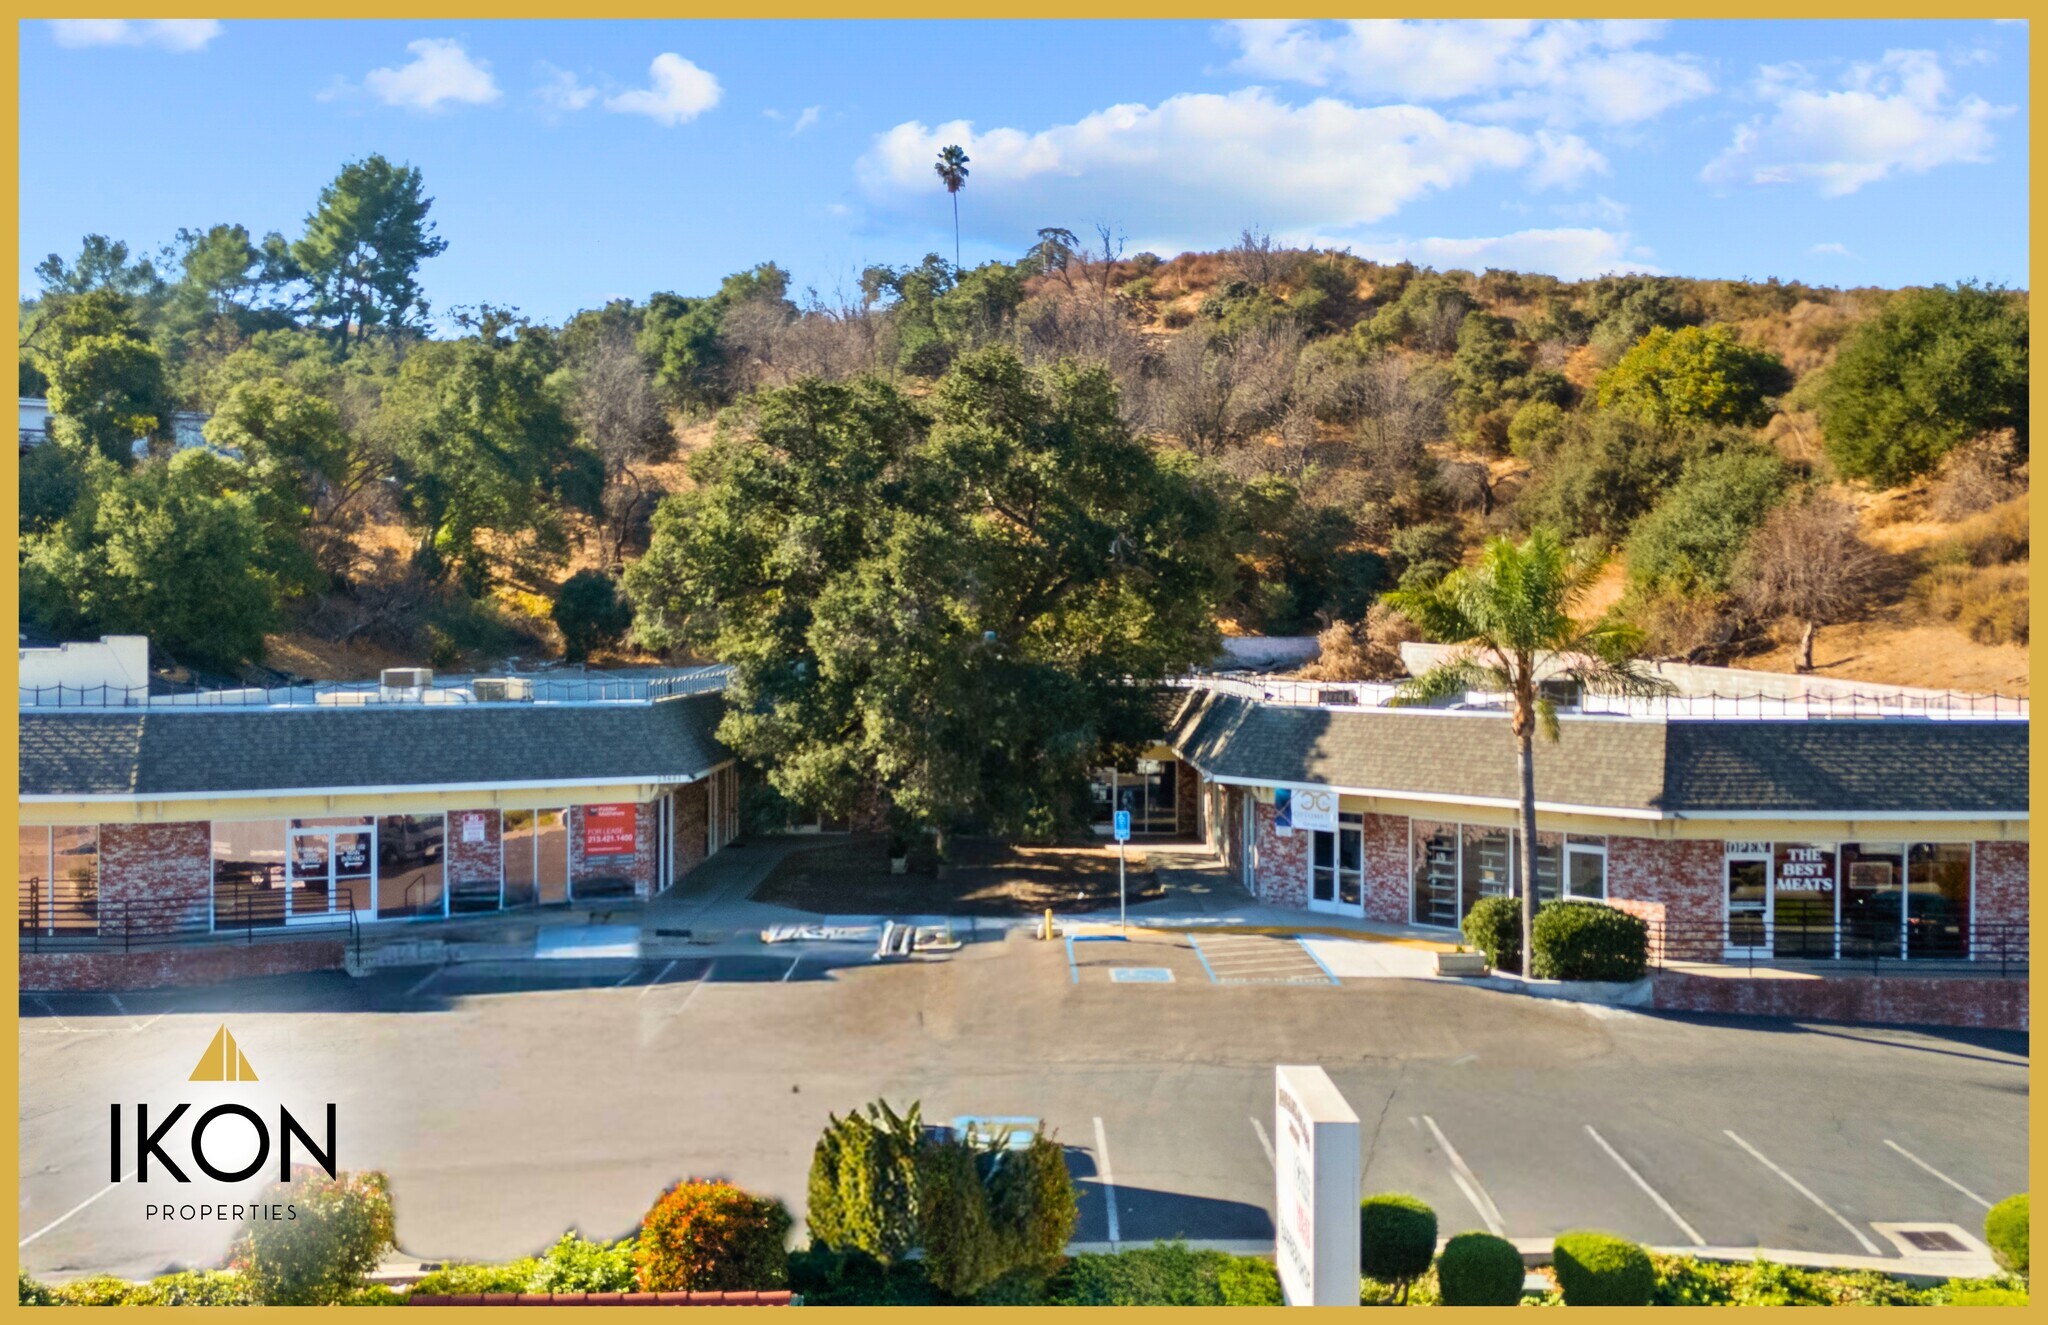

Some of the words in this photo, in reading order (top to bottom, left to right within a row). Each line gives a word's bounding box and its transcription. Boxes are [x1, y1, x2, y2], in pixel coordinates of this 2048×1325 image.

[603, 826, 624, 835] LEASE
[1787, 848, 1822, 861] THE
[1783, 863, 1826, 876] BEST
[1777, 878, 1833, 891] MEATS
